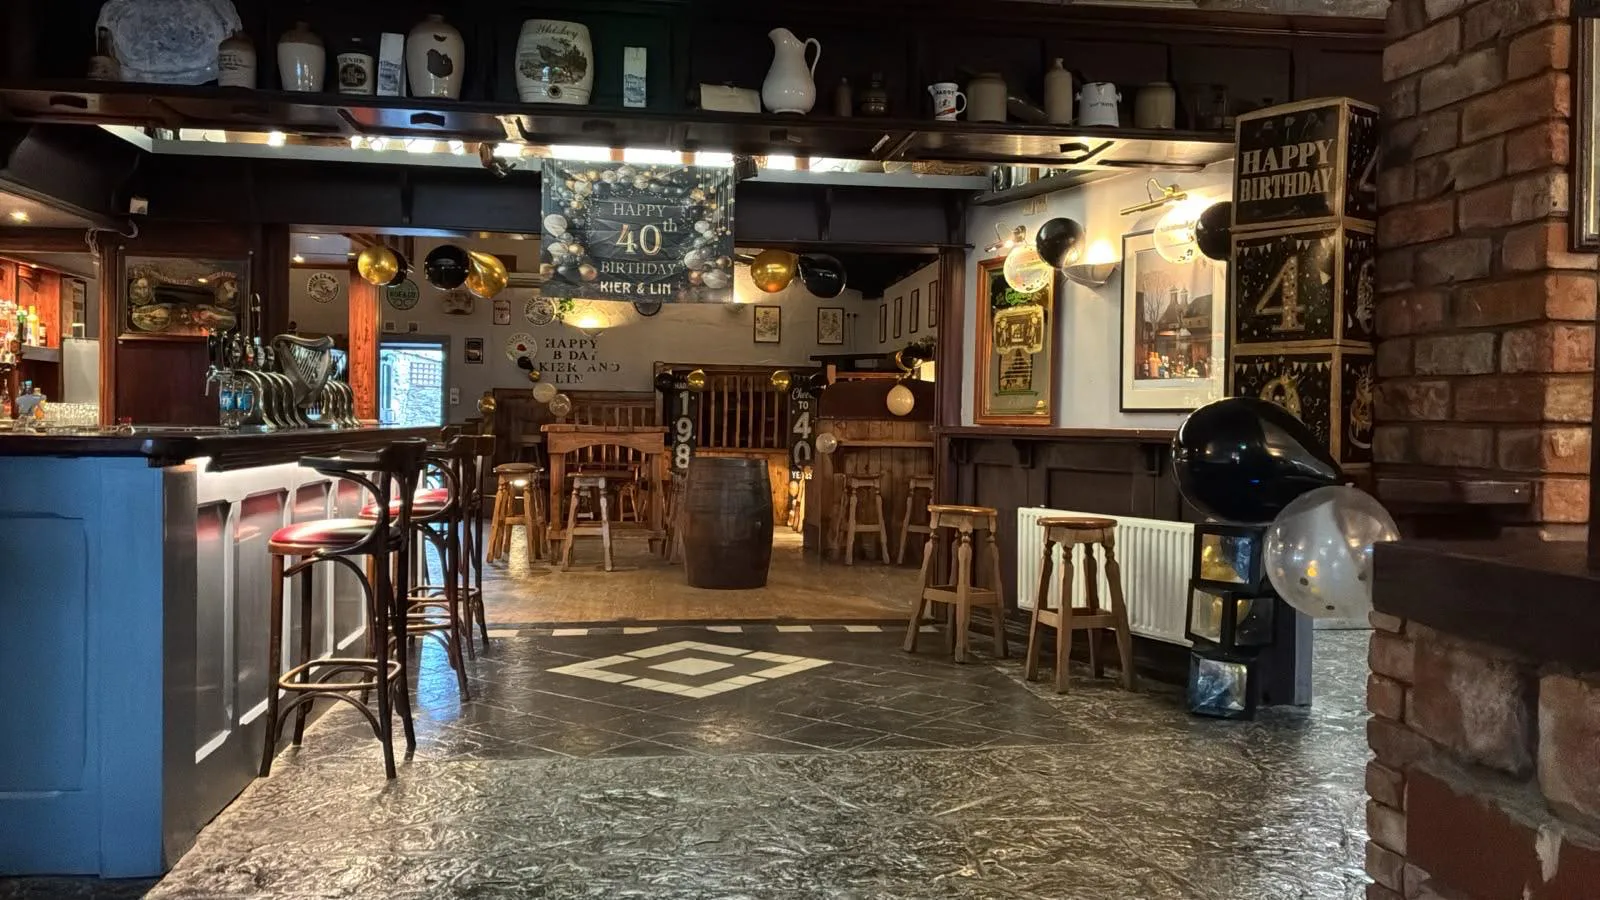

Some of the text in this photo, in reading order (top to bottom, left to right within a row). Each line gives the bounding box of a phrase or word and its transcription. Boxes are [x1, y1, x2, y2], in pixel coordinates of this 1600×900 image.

[1241, 139, 1334, 175] HAPPY
[1240, 167, 1334, 202] BIRTHDAY
[613, 202, 667, 218] HAPPY
[615, 218, 678, 257] 40th
[601, 261, 677, 276] BIRTHDAY
[600, 280, 672, 295] KIER & LIN
[1255, 255, 1306, 333] 4
[544, 338, 599, 349] HAPPY
[553, 350, 562, 360] B
[539, 362, 577, 373] KIER
[555, 373, 584, 384] LIN
[797, 400, 809, 411] TO
[675, 390, 693, 469] 198
